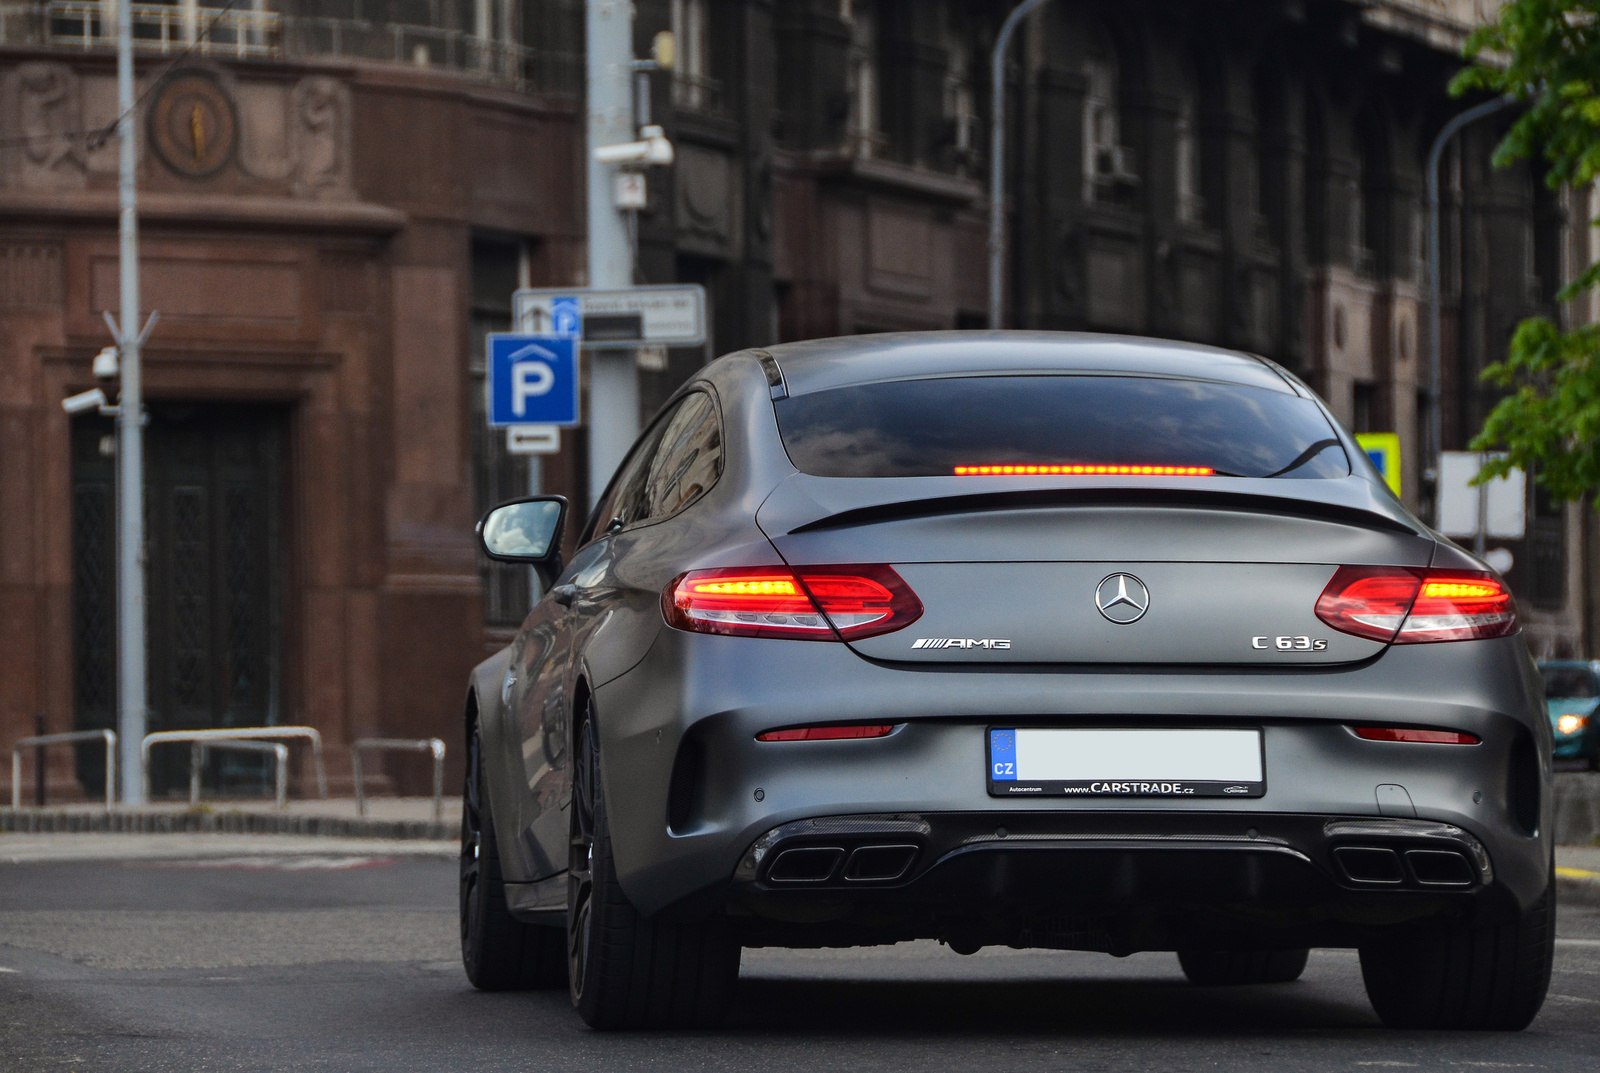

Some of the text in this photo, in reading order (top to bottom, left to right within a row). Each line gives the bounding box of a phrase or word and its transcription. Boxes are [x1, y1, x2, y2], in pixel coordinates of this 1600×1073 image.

[511, 361, 555, 417] P
[1252, 636, 1268, 649] C
[994, 762, 1014, 775] CZ
[1064, 782, 1195, 794] www.CARSTRADE.cz
